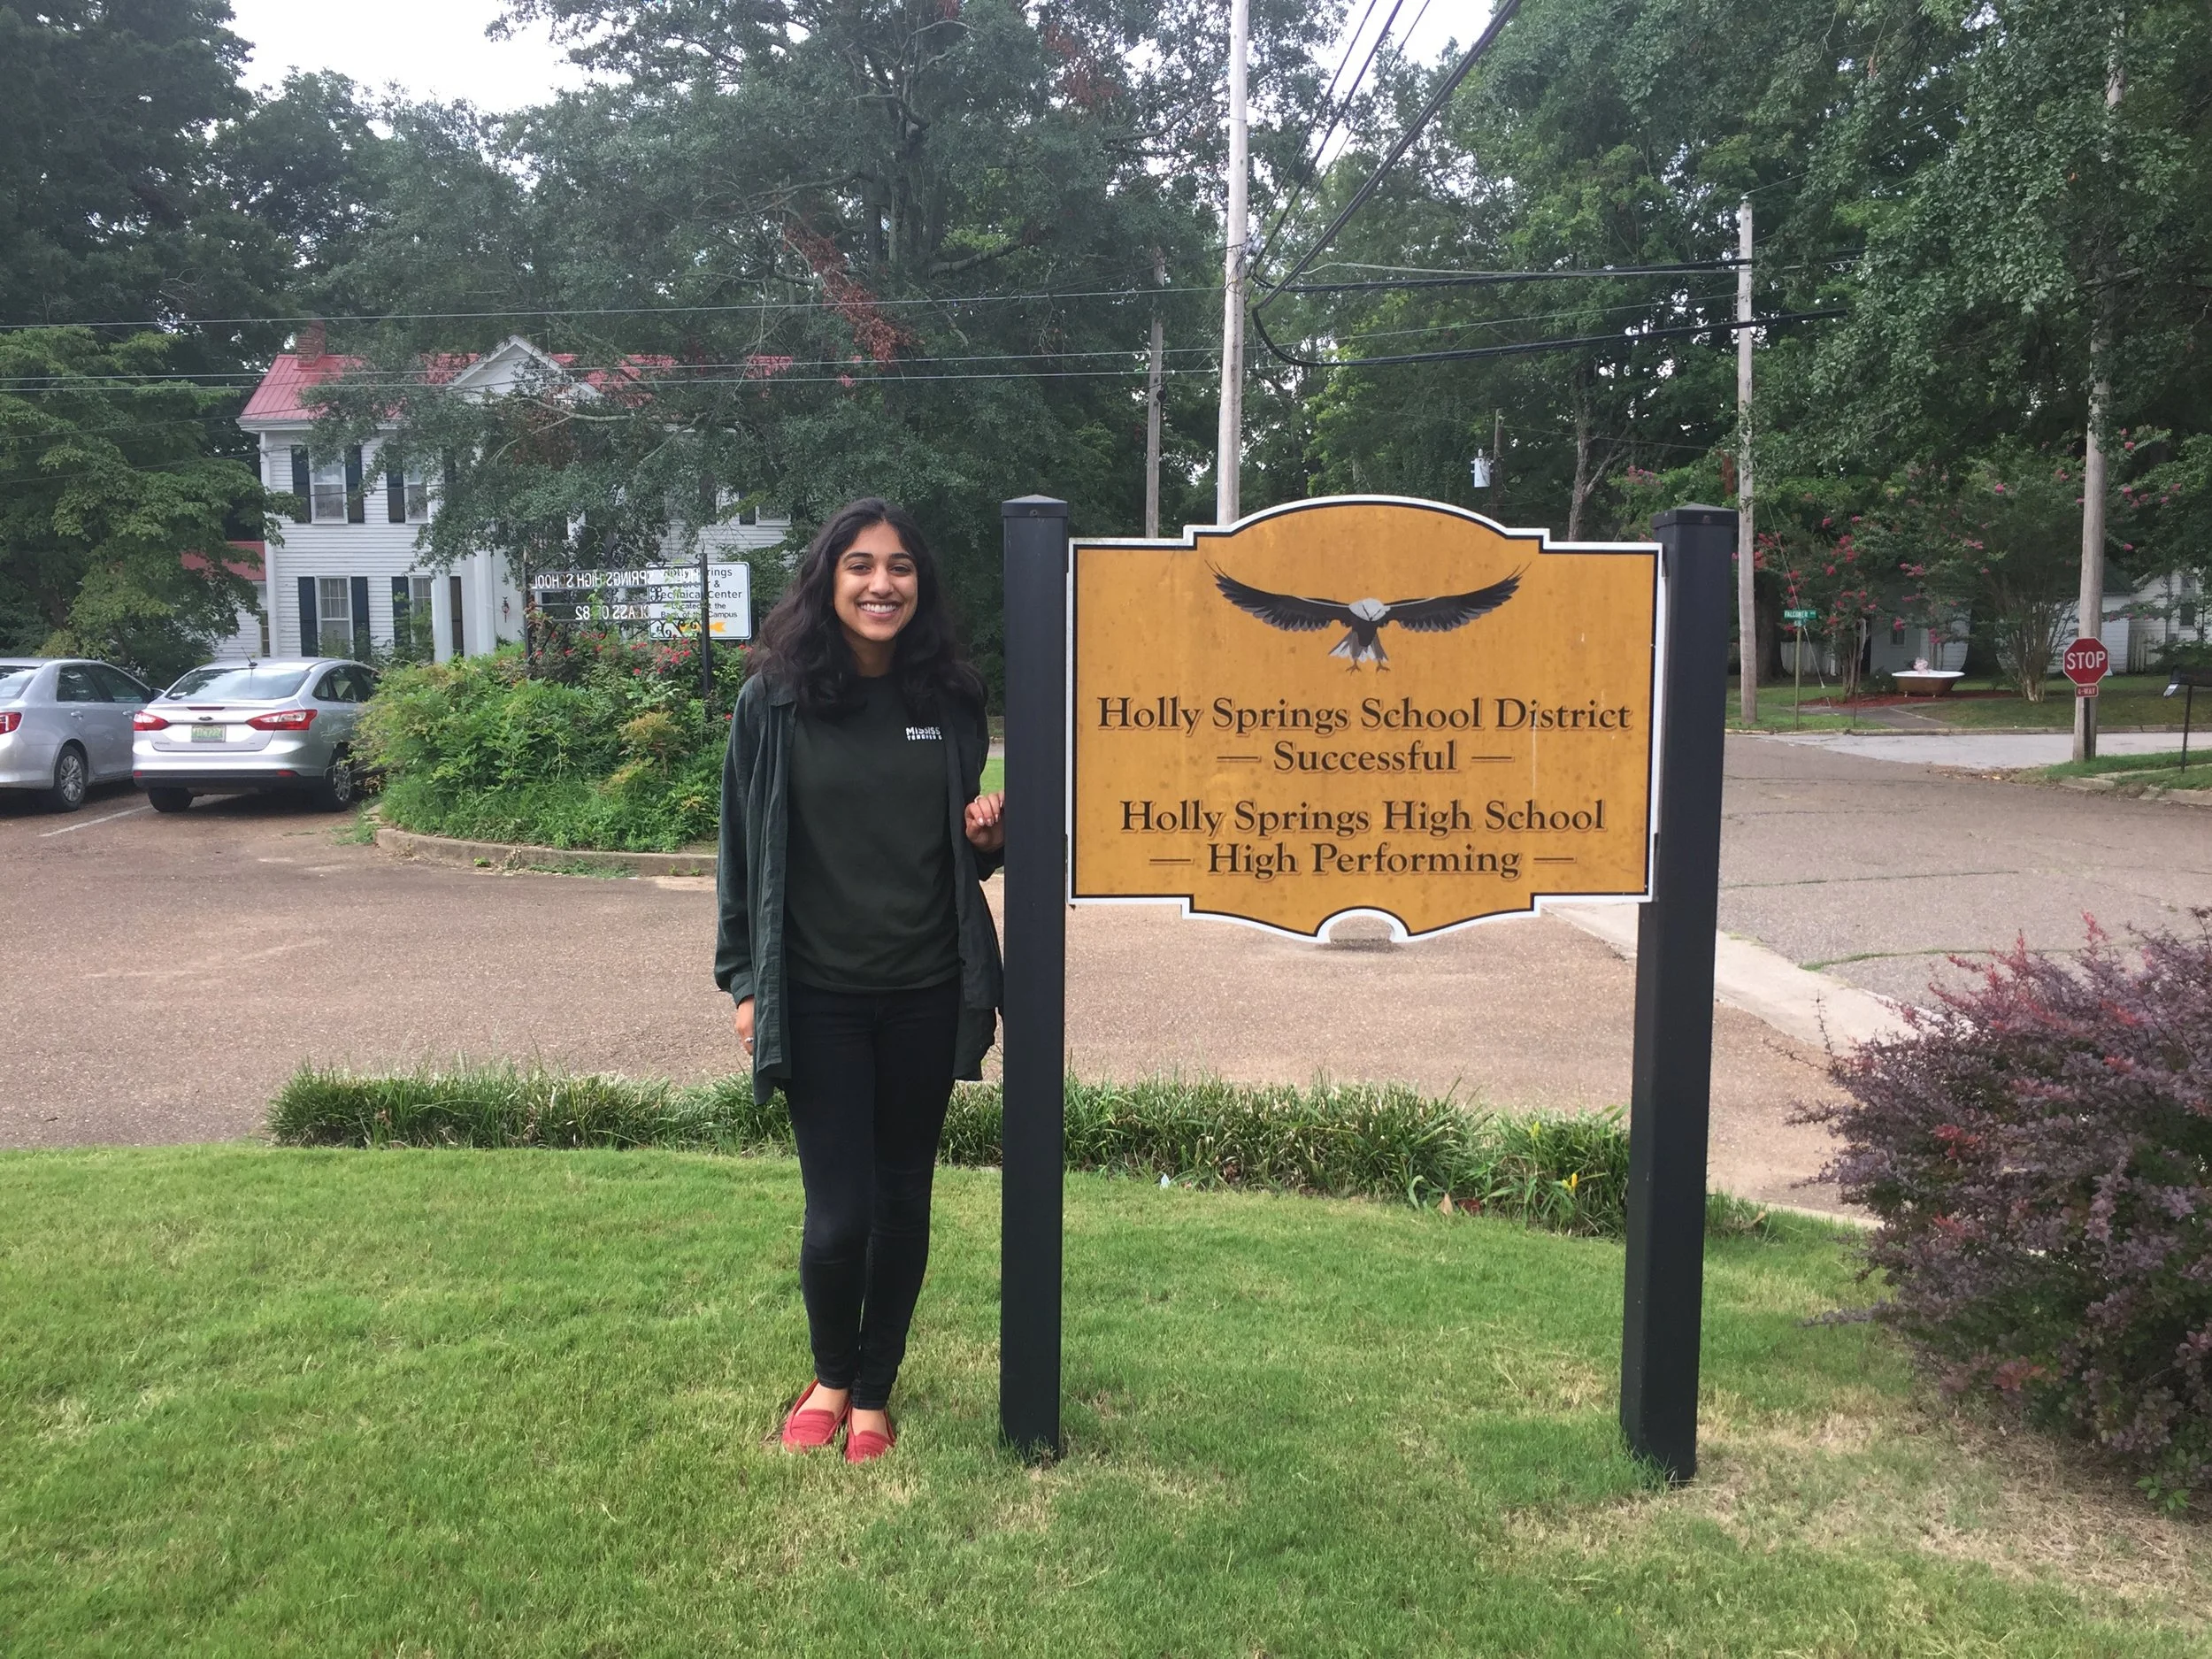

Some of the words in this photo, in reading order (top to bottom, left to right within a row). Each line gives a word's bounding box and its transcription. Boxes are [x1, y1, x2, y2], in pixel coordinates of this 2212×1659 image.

[2066, 650, 2106, 670] STOP
[1097, 695, 1201, 735] Holly
[1212, 696, 1348, 734] Springs
[1360, 696, 1482, 728] School
[1493, 697, 1631, 728] District
[1273, 740, 1457, 771] Successful
[1119, 799, 1223, 837] Holly
[1234, 799, 1370, 837] Springs
[1382, 798, 1473, 836] High
[1485, 798, 1605, 830] School
[1207, 841, 1298, 879] High
[1310, 841, 1520, 879] Performing
